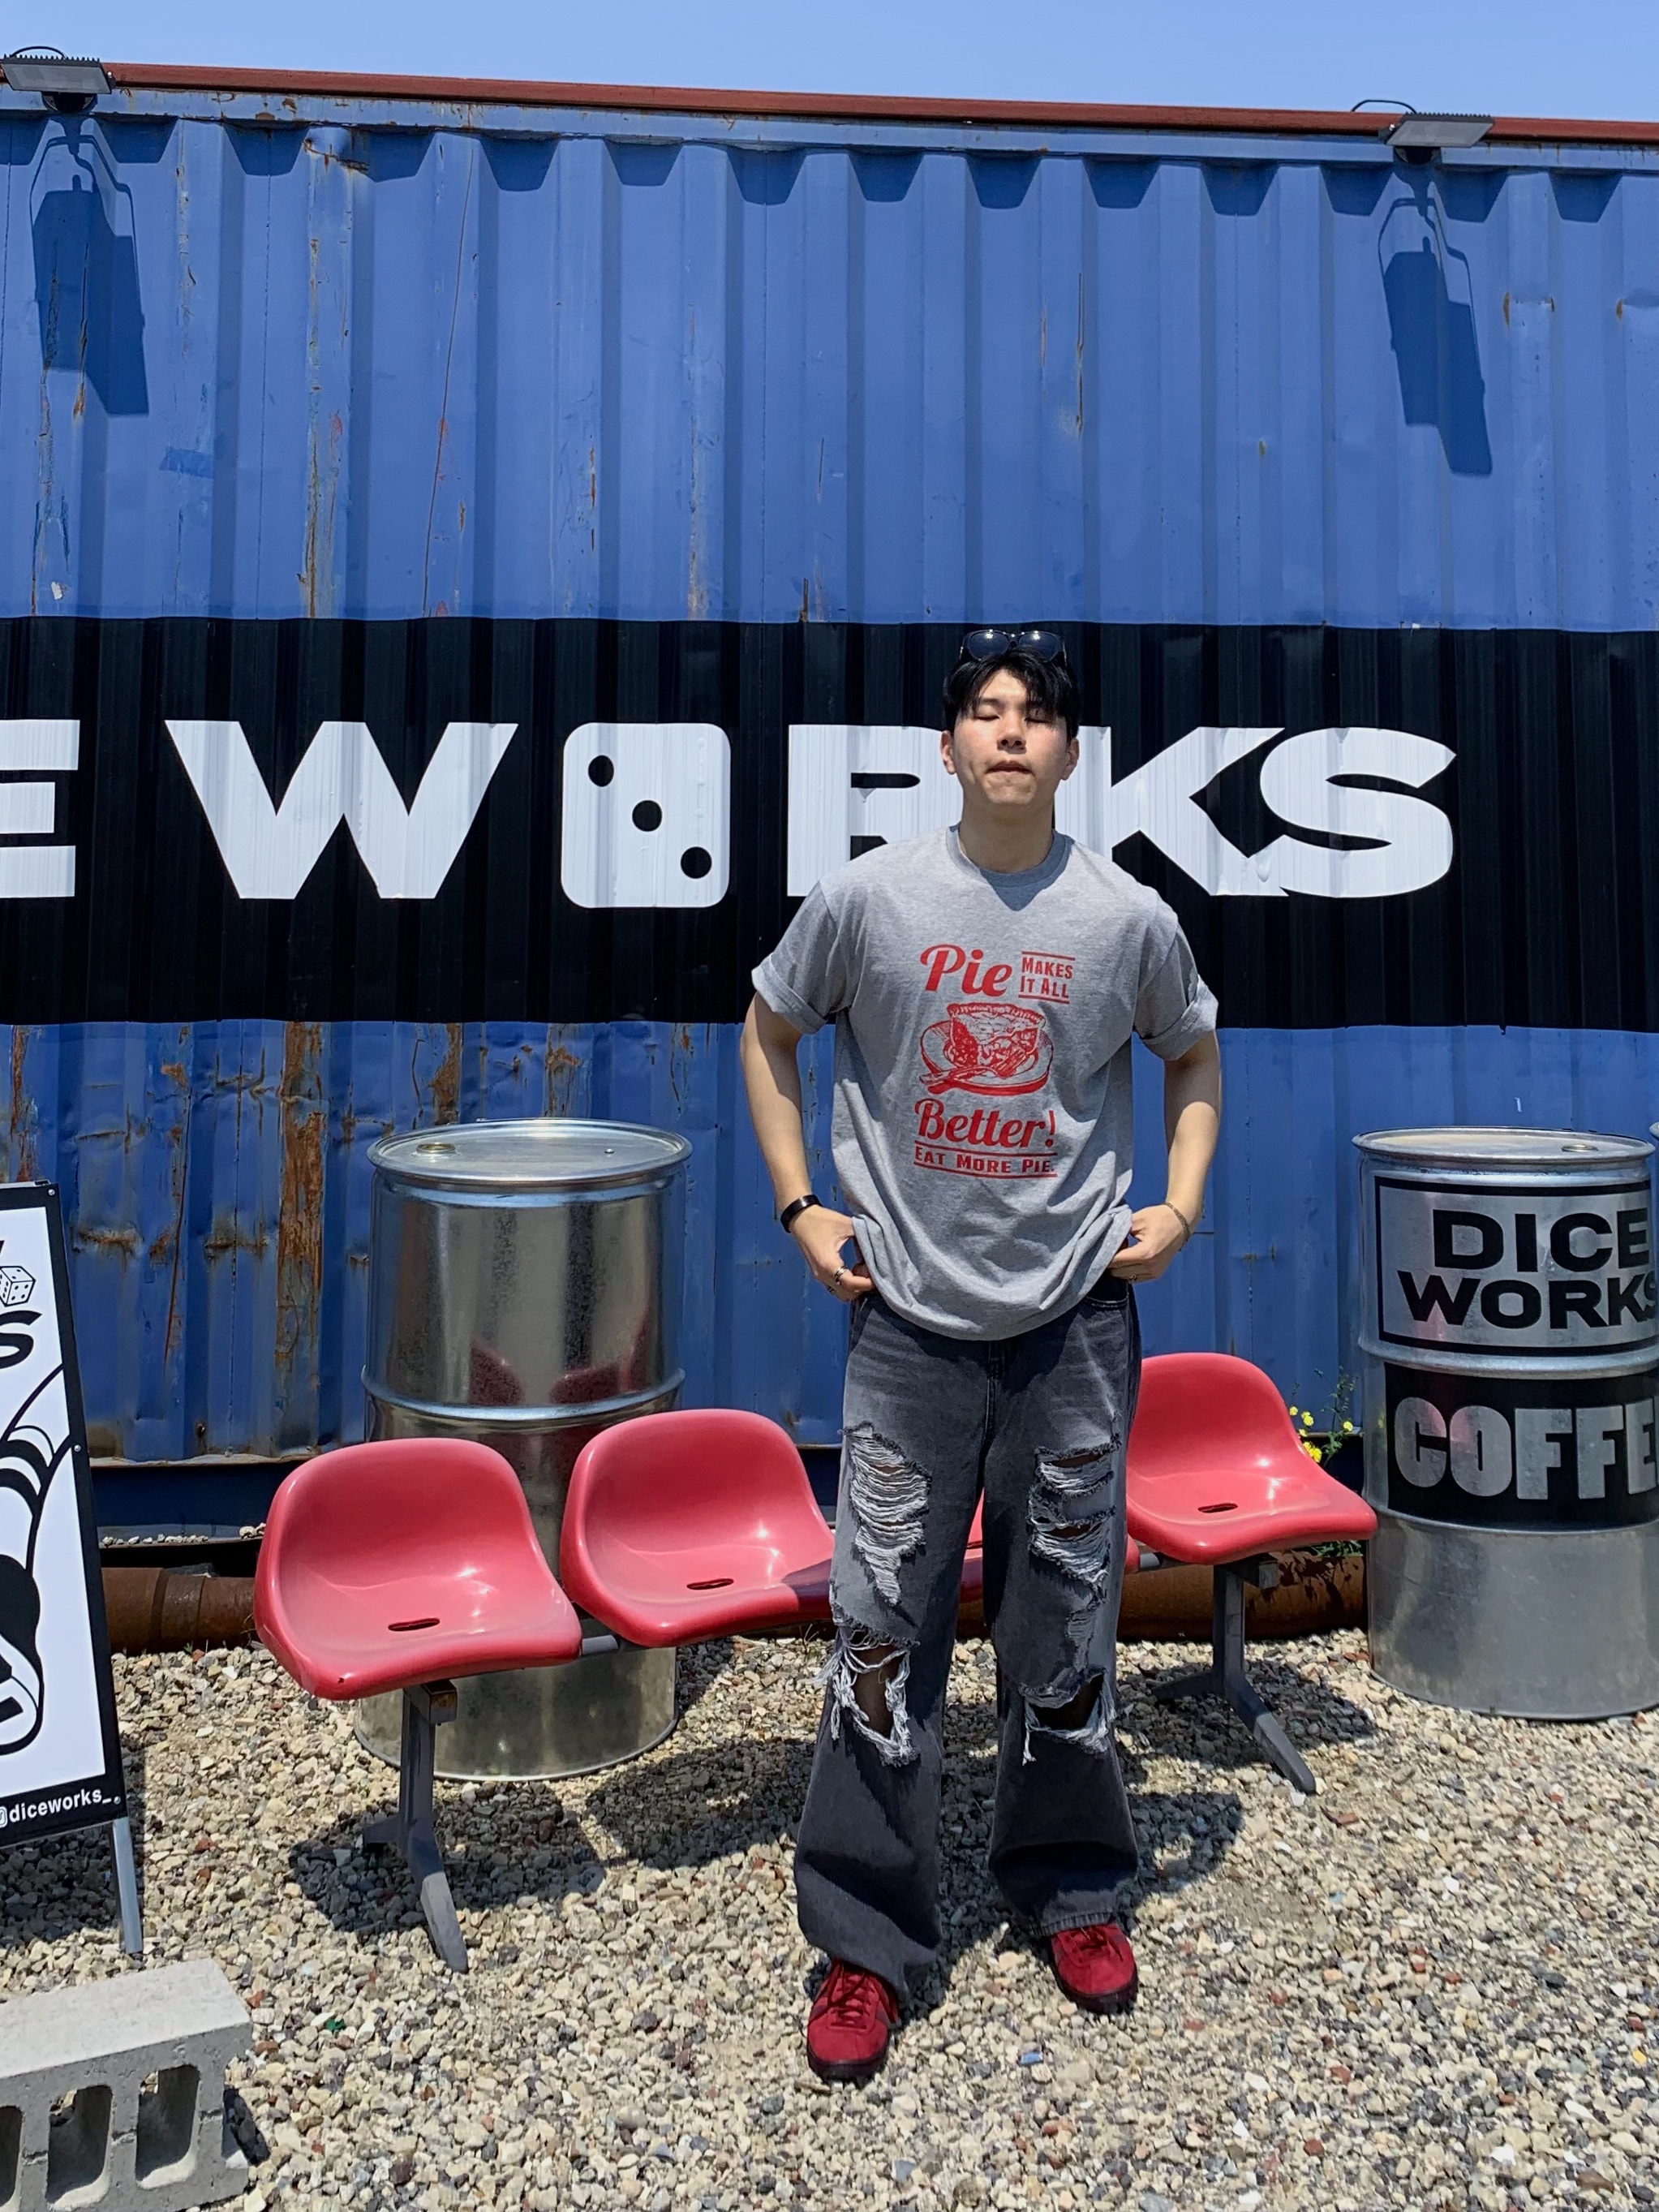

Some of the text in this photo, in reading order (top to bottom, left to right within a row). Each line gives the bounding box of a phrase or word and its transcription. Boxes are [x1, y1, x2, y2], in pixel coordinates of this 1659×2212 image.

[919, 944, 1013, 997] Pie
[1020, 975, 1069, 998] IT ALL
[1021, 957, 1073, 979] MAKES
[914, 1098, 1056, 1148] Better!
[914, 1146, 946, 1165] EAT
[956, 1153, 1012, 1173] MORE
[1433, 1207, 1650, 1273] DICE
[1397, 1270, 1657, 1329] WORKS
[1394, 1394, 1659, 1500] COFFE
